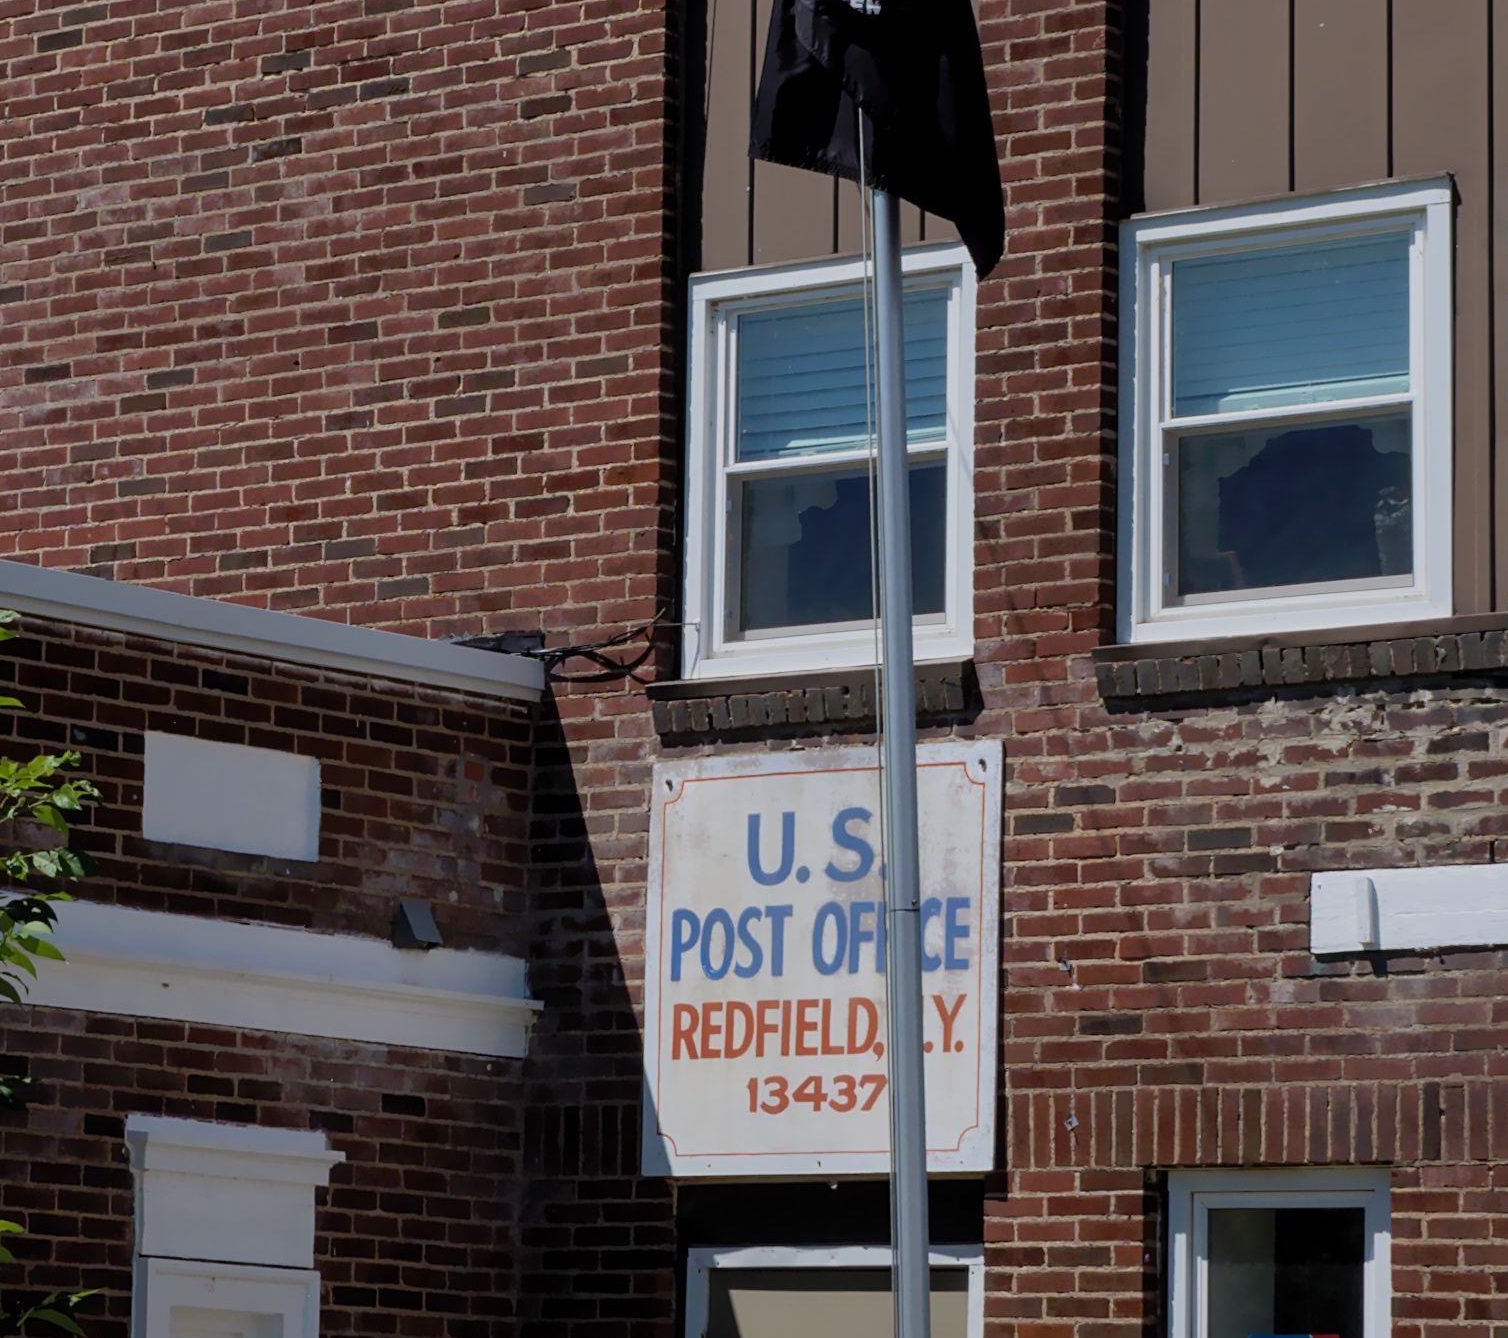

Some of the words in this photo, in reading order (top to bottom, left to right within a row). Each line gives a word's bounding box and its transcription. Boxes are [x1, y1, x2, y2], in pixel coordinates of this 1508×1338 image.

[670, 904, 793, 982] POST
[671, 996, 885, 1062] REDFIELD,
[921, 993, 968, 1054] .Y.
[746, 1073, 888, 1115] 13437
